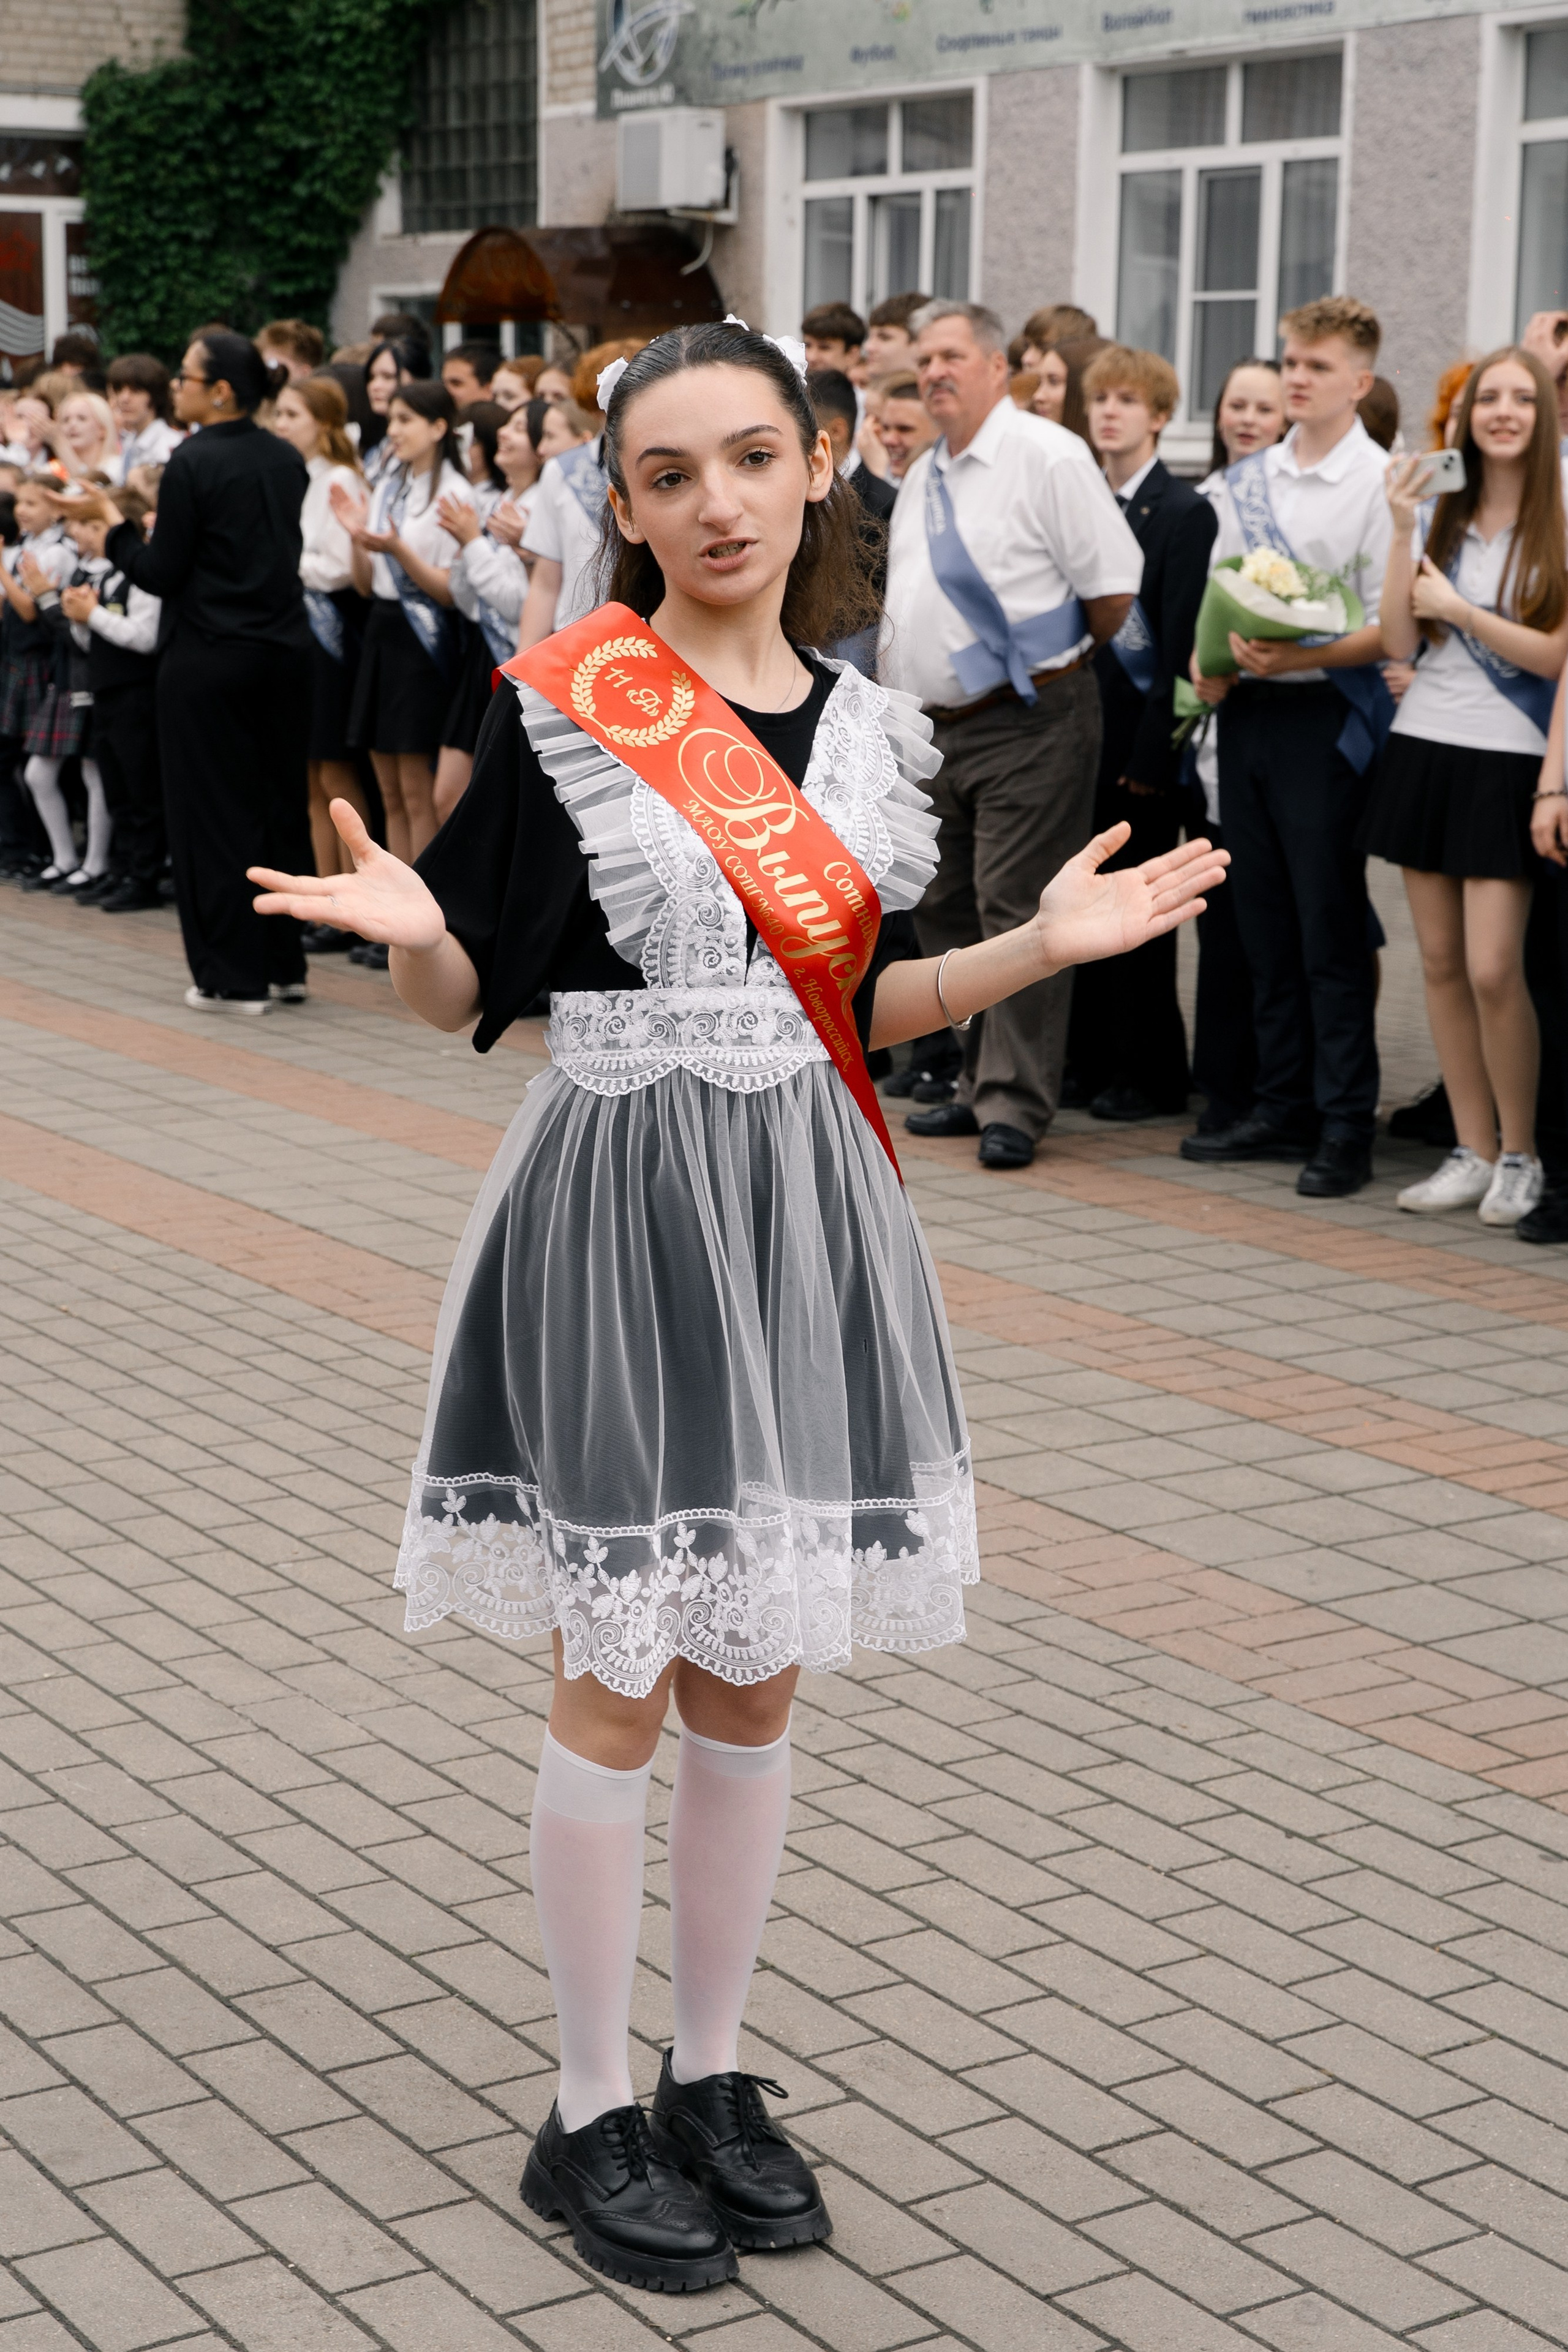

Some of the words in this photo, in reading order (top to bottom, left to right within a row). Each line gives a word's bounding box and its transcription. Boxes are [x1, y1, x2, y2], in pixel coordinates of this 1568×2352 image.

[604, 667, 633, 688] 11
[682, 799, 735, 851] МАОУ
[725, 855, 764, 898] СОШ
[801, 978, 854, 1072] Новороссийск
